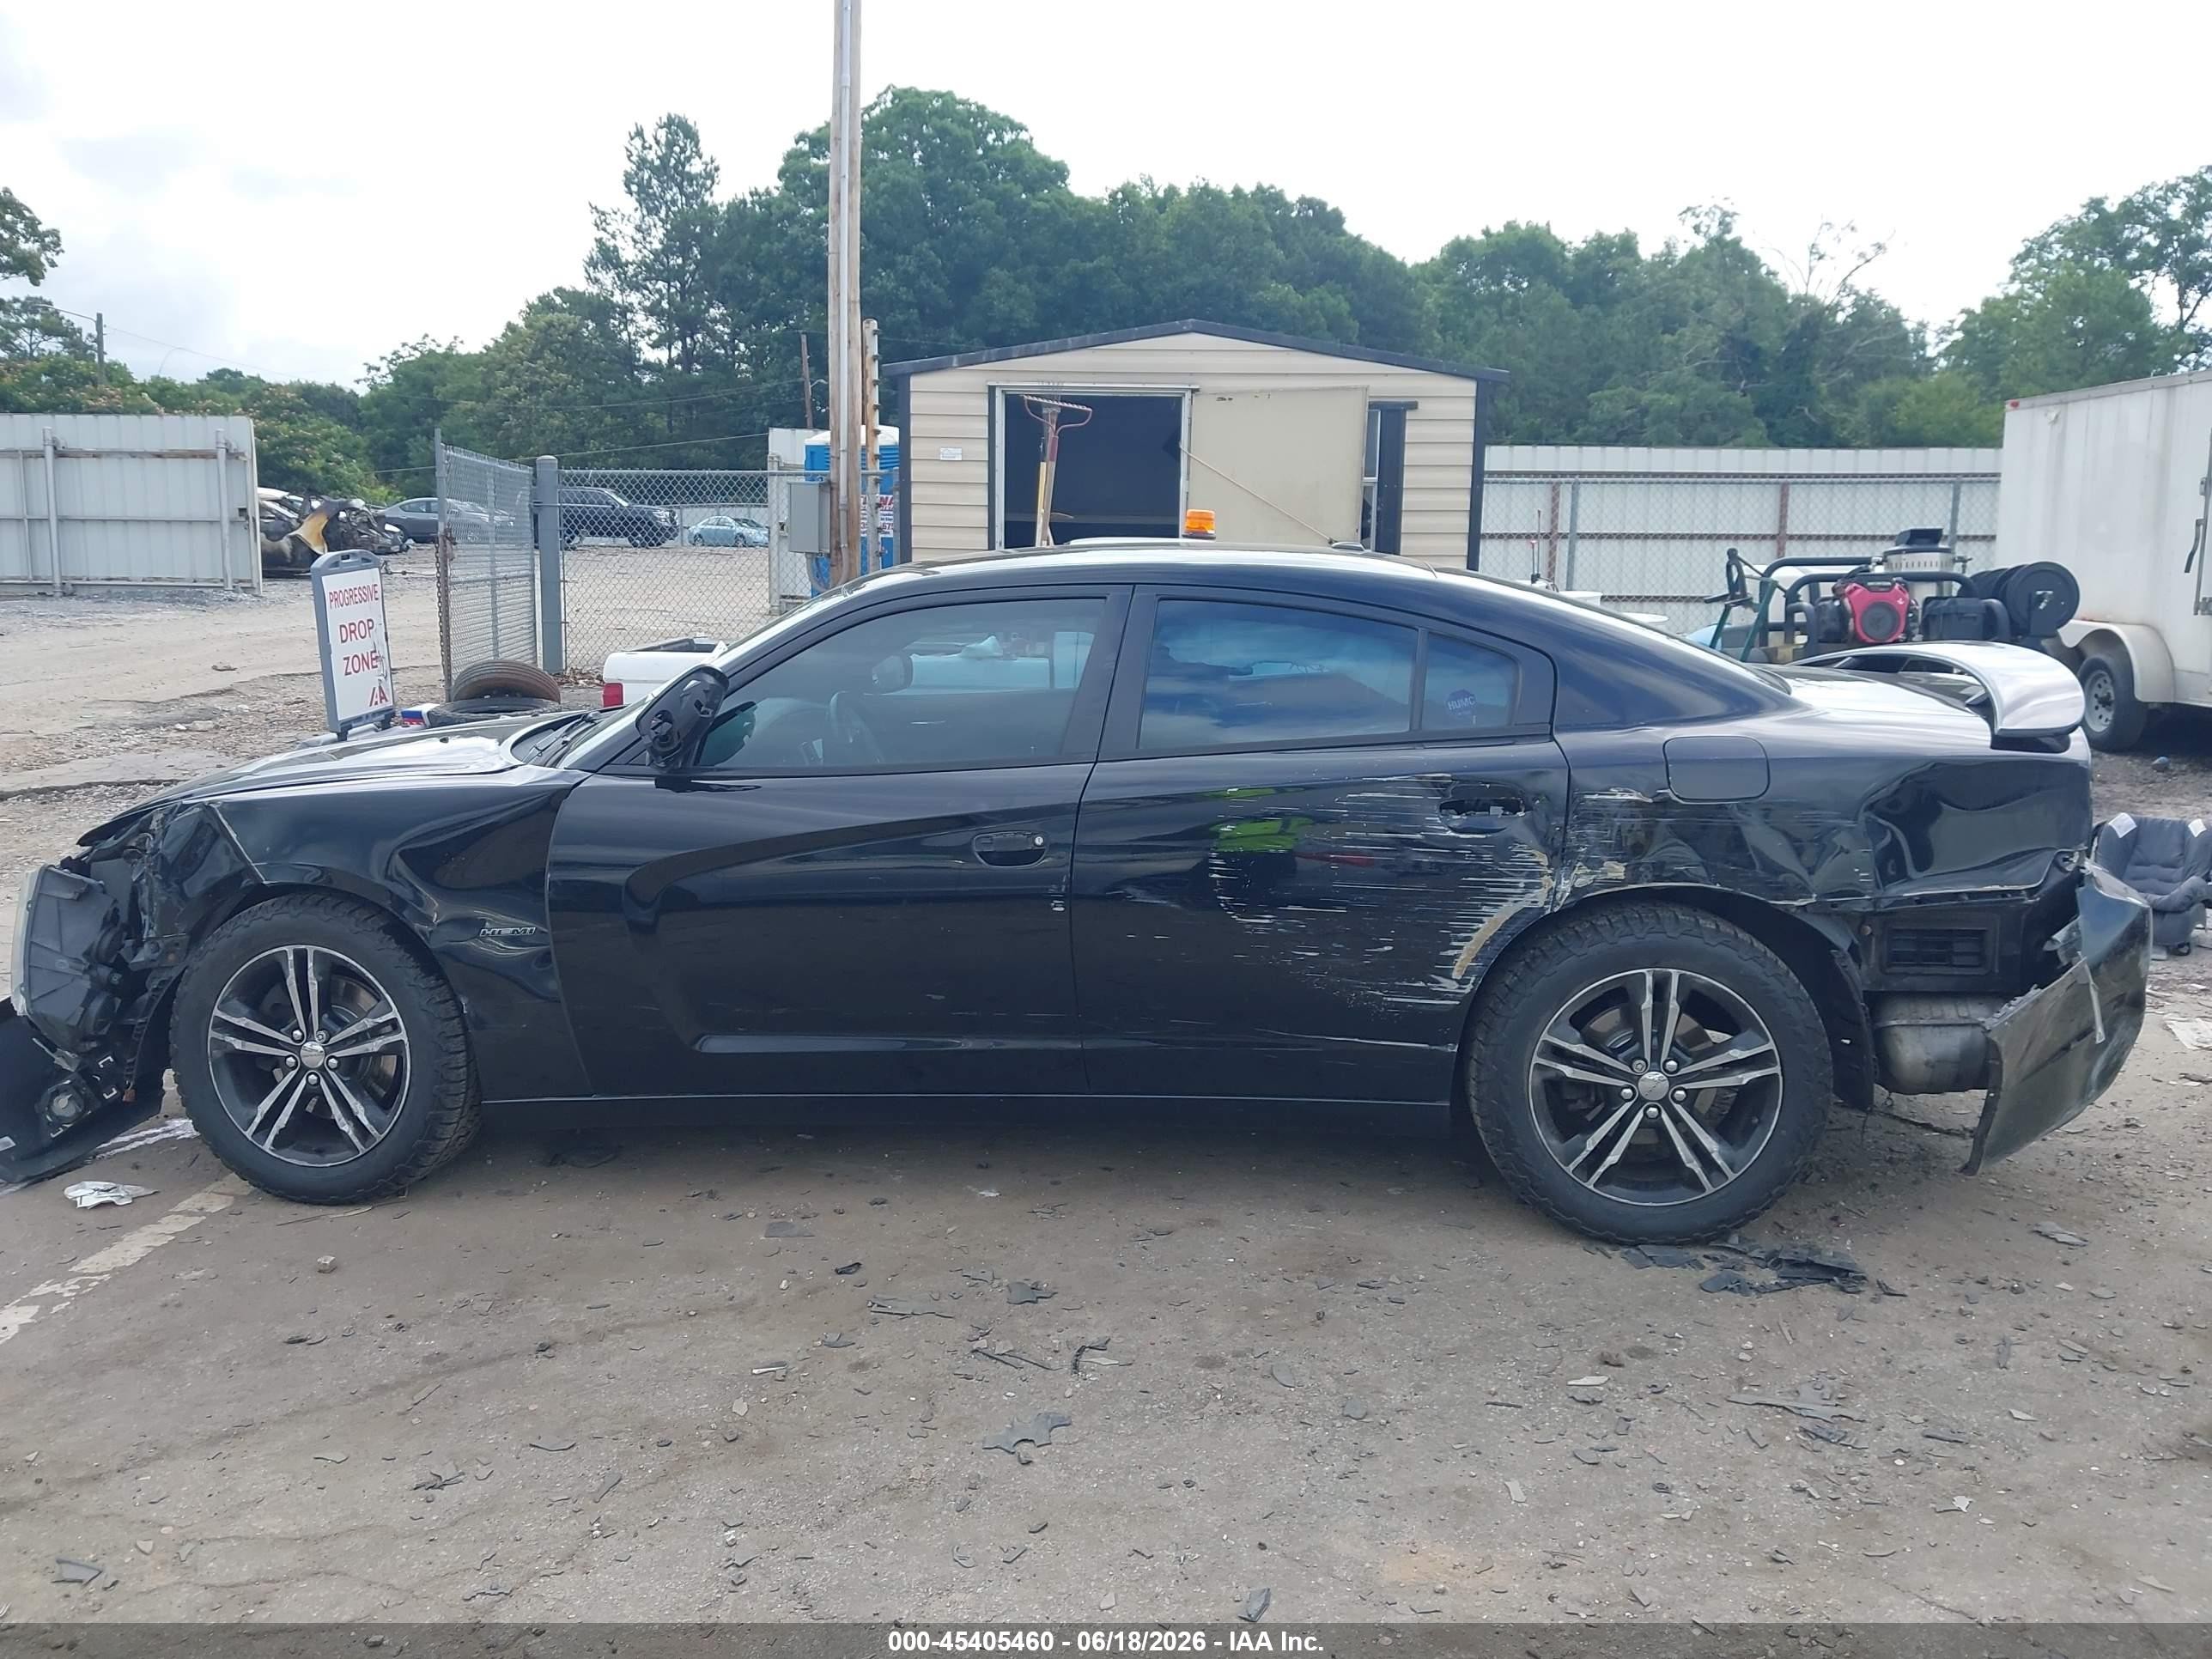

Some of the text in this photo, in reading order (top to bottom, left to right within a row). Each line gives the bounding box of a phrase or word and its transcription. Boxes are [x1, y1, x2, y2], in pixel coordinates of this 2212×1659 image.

[329, 583, 380, 609] PROGRESSIVE
[339, 618, 375, 644] DROP
[343, 650, 379, 677] ZONE
